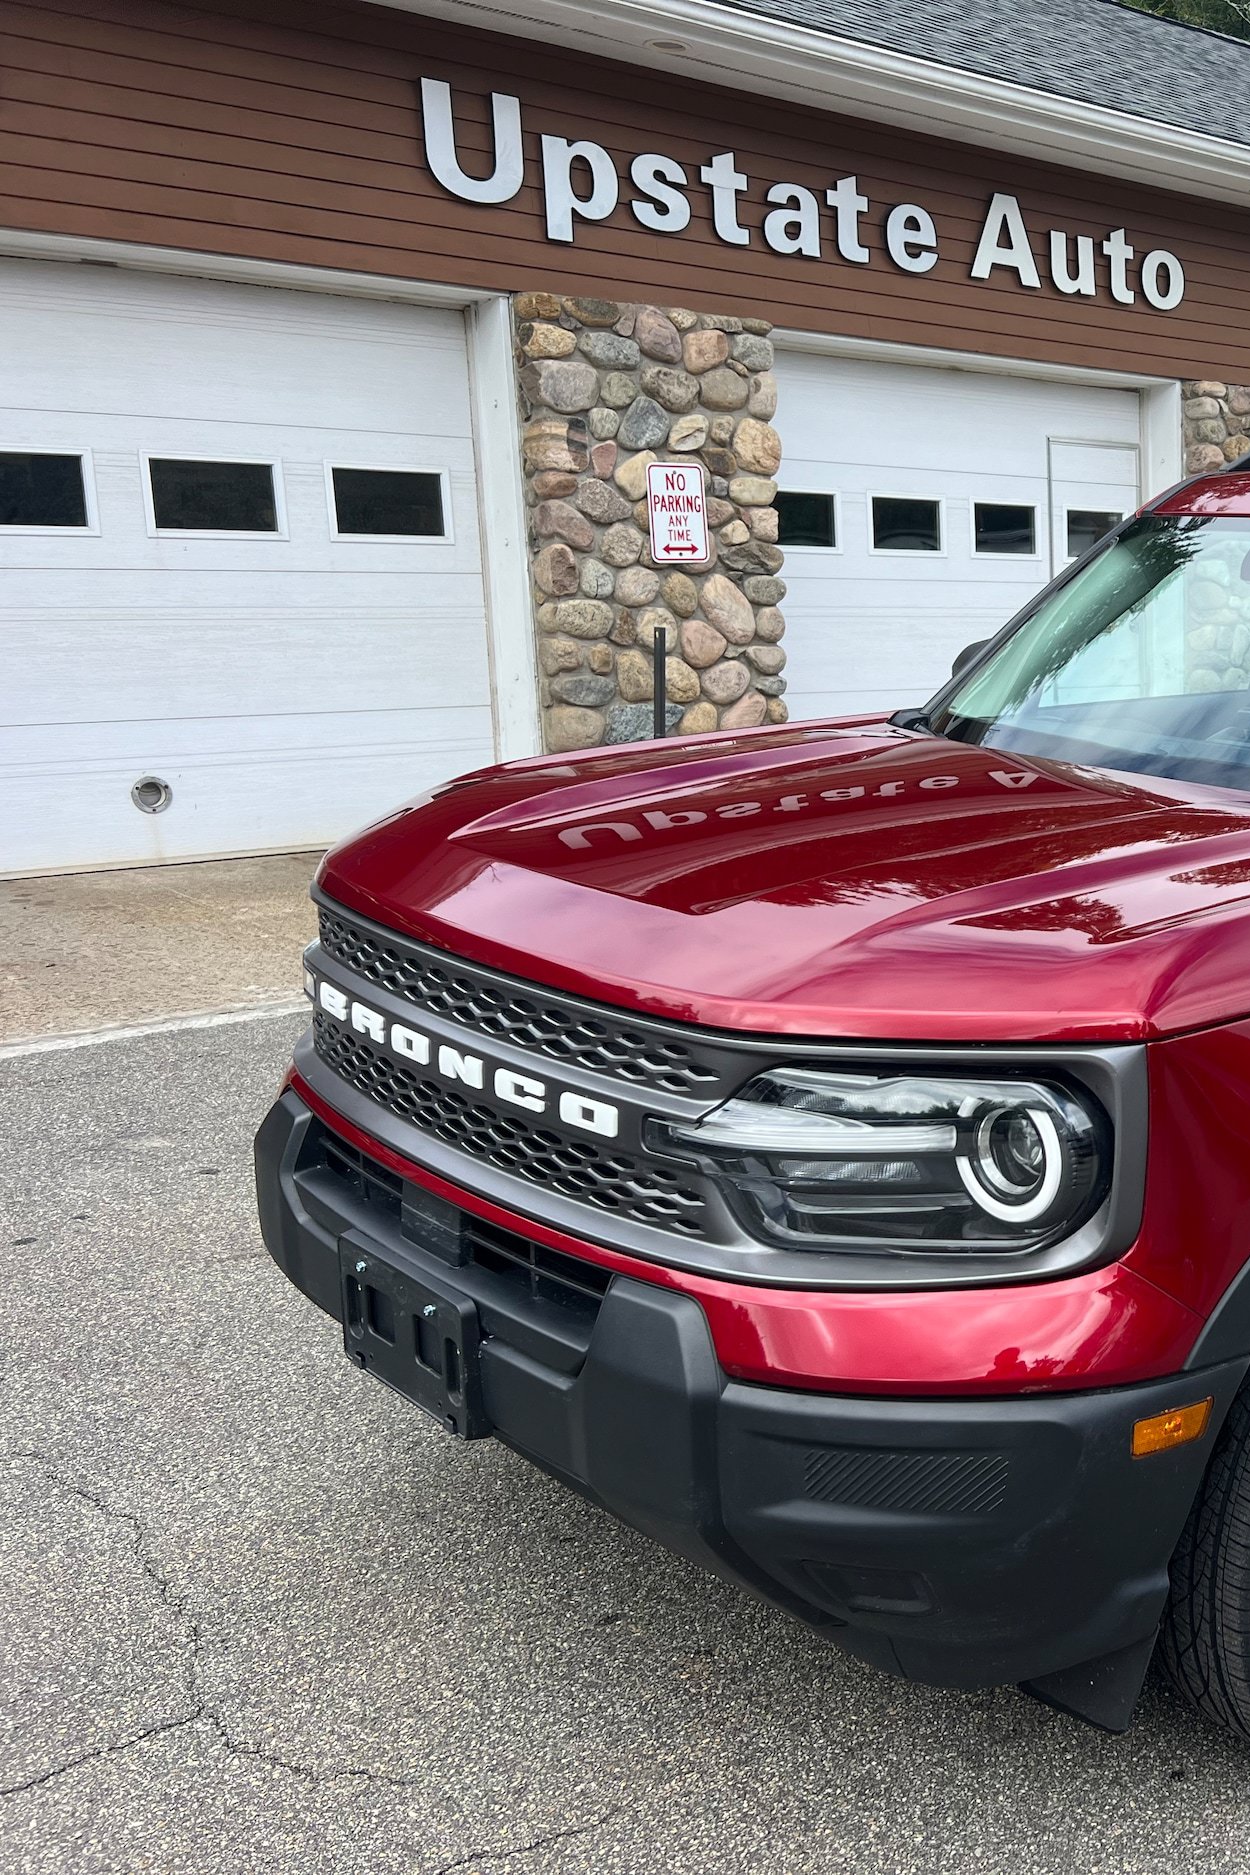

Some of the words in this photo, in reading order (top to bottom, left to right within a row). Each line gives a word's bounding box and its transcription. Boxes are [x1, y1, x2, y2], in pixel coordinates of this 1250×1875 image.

[420, 76, 939, 274] Upstate
[970, 193, 1185, 311] Auto
[665, 473, 686, 491] NO
[653, 495, 701, 513] PARKING
[668, 515, 689, 527] ANY
[667, 529, 693, 541] TIME
[319, 981, 619, 1138] BRONCO
